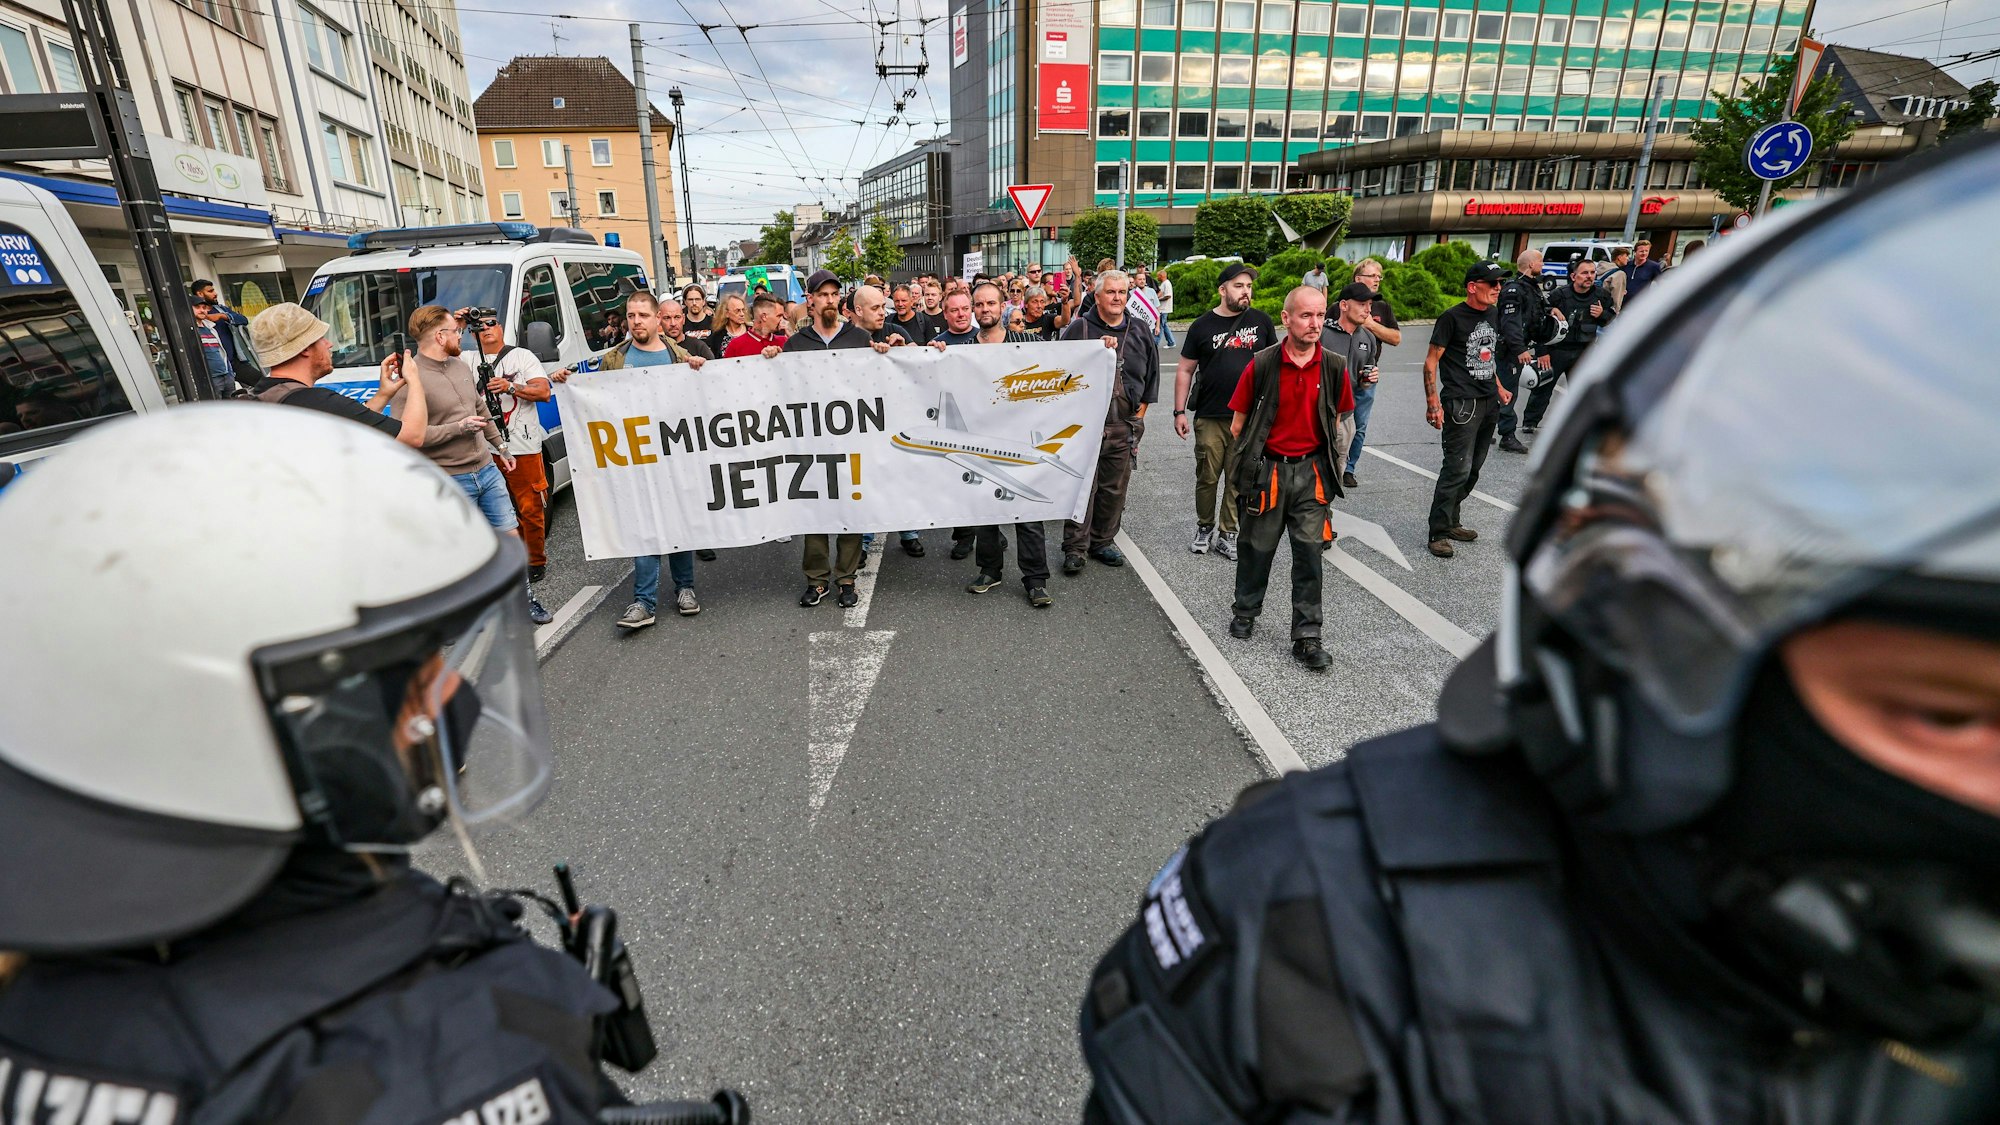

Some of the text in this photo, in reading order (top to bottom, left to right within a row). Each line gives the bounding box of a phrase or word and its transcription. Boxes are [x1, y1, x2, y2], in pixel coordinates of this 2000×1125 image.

[1479, 203, 1543, 215] IMMOBILIEN
[1546, 203, 1584, 215] CENTER
[1641, 202, 1662, 214] LBS
[1, 253, 41, 266] 31332
[313, 276, 330, 285] NRW
[1009, 373, 1073, 394] HEIMAT!
[586, 396, 886, 469] REMIGRATION
[706, 452, 862, 512] JETZT!
